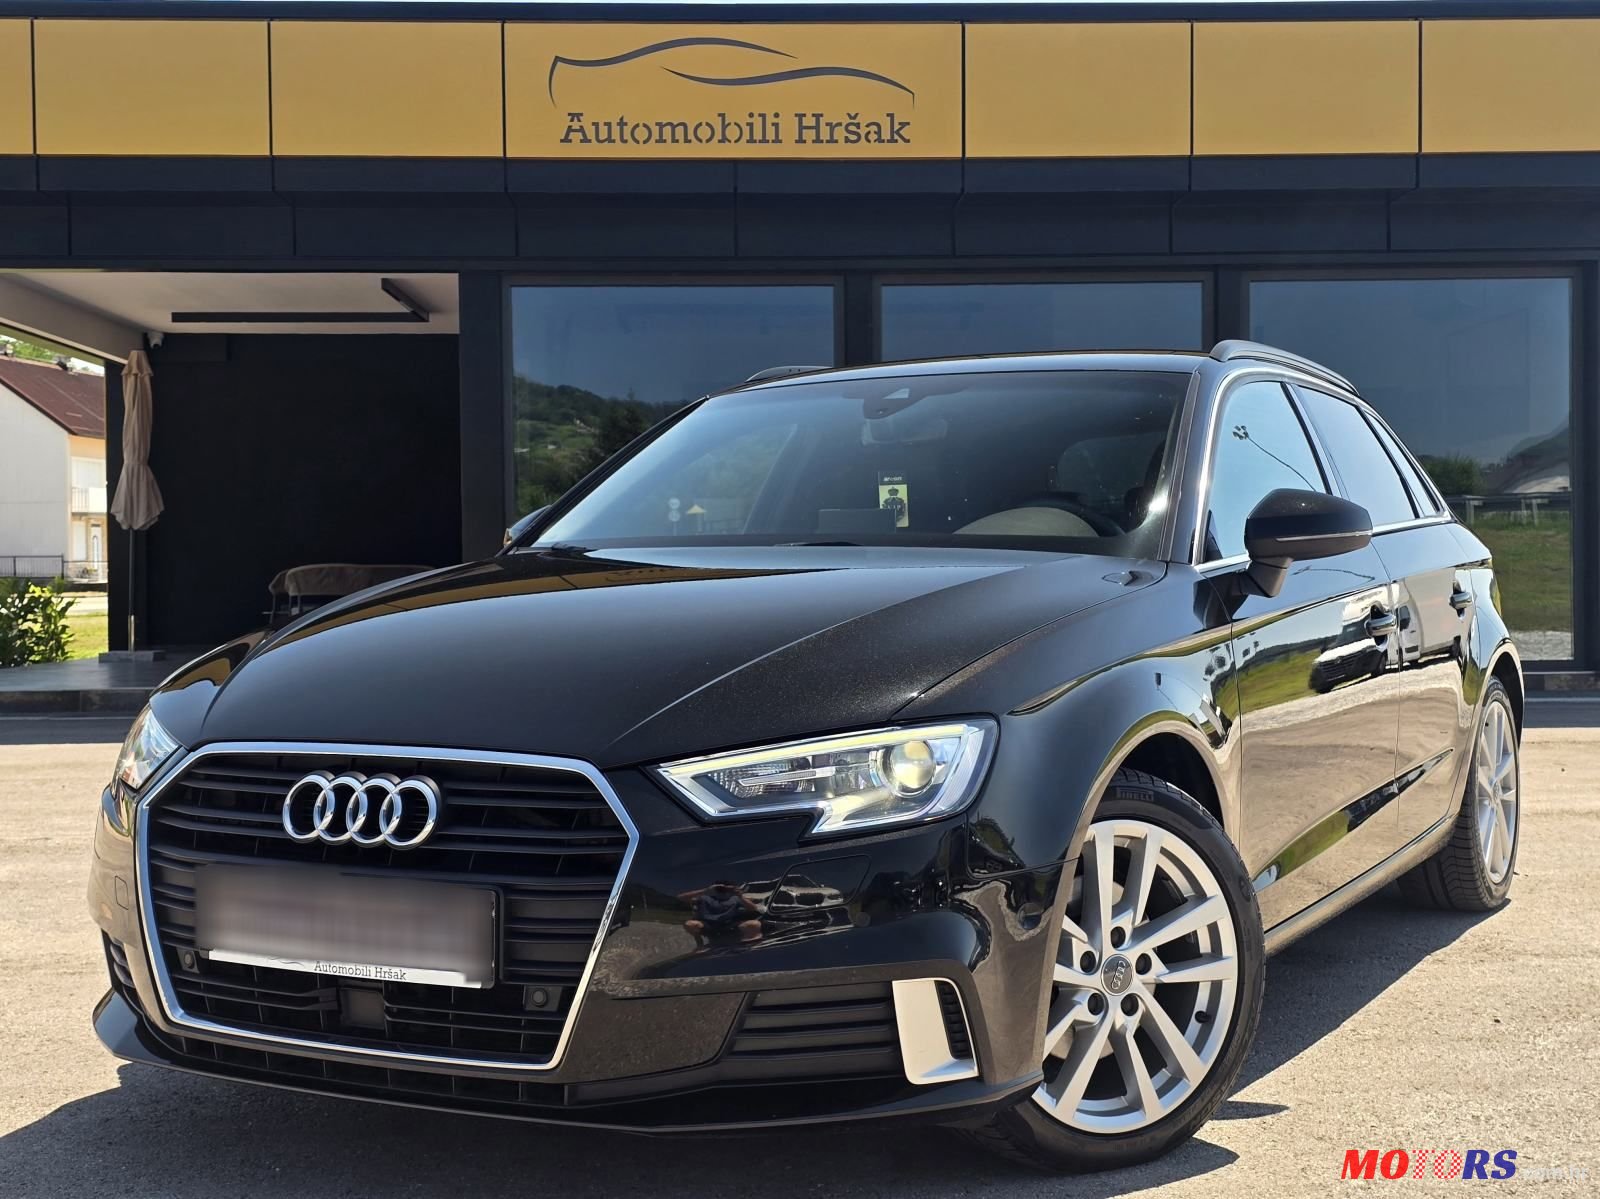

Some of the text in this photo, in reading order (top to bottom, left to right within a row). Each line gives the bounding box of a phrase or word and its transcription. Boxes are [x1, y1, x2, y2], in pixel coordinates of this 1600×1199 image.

[560, 112, 912, 145] Automobili Hršak
[314, 960, 407, 981] Automobili Hršak
